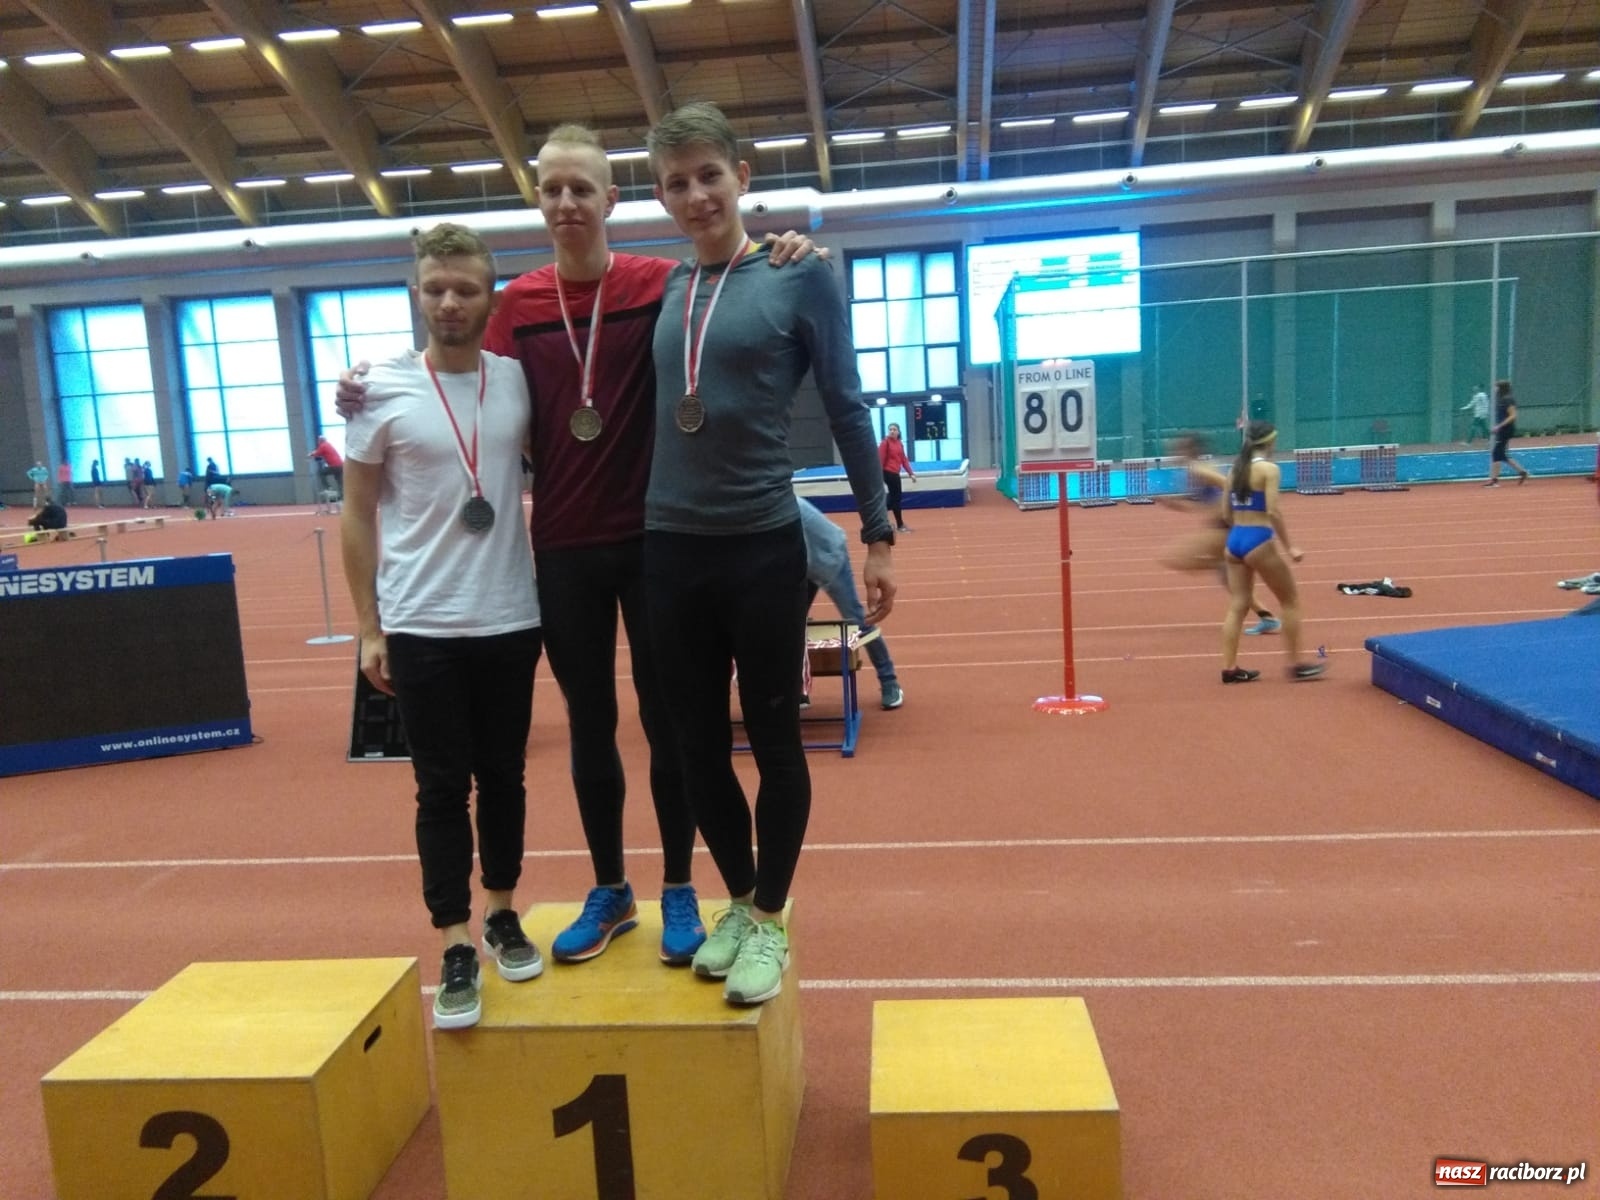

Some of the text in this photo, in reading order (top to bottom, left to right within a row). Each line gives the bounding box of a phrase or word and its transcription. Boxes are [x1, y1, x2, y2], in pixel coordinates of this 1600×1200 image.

[1018, 371, 1051, 384] FROM
[1065, 367, 1092, 380] LINE
[0, 565, 154, 597] NESYSTEM
[100, 727, 241, 752] www.onlinesystem.cz
[139, 1110, 237, 1200] 2
[552, 1074, 636, 1200] 1
[957, 1133, 1039, 1200] 3
